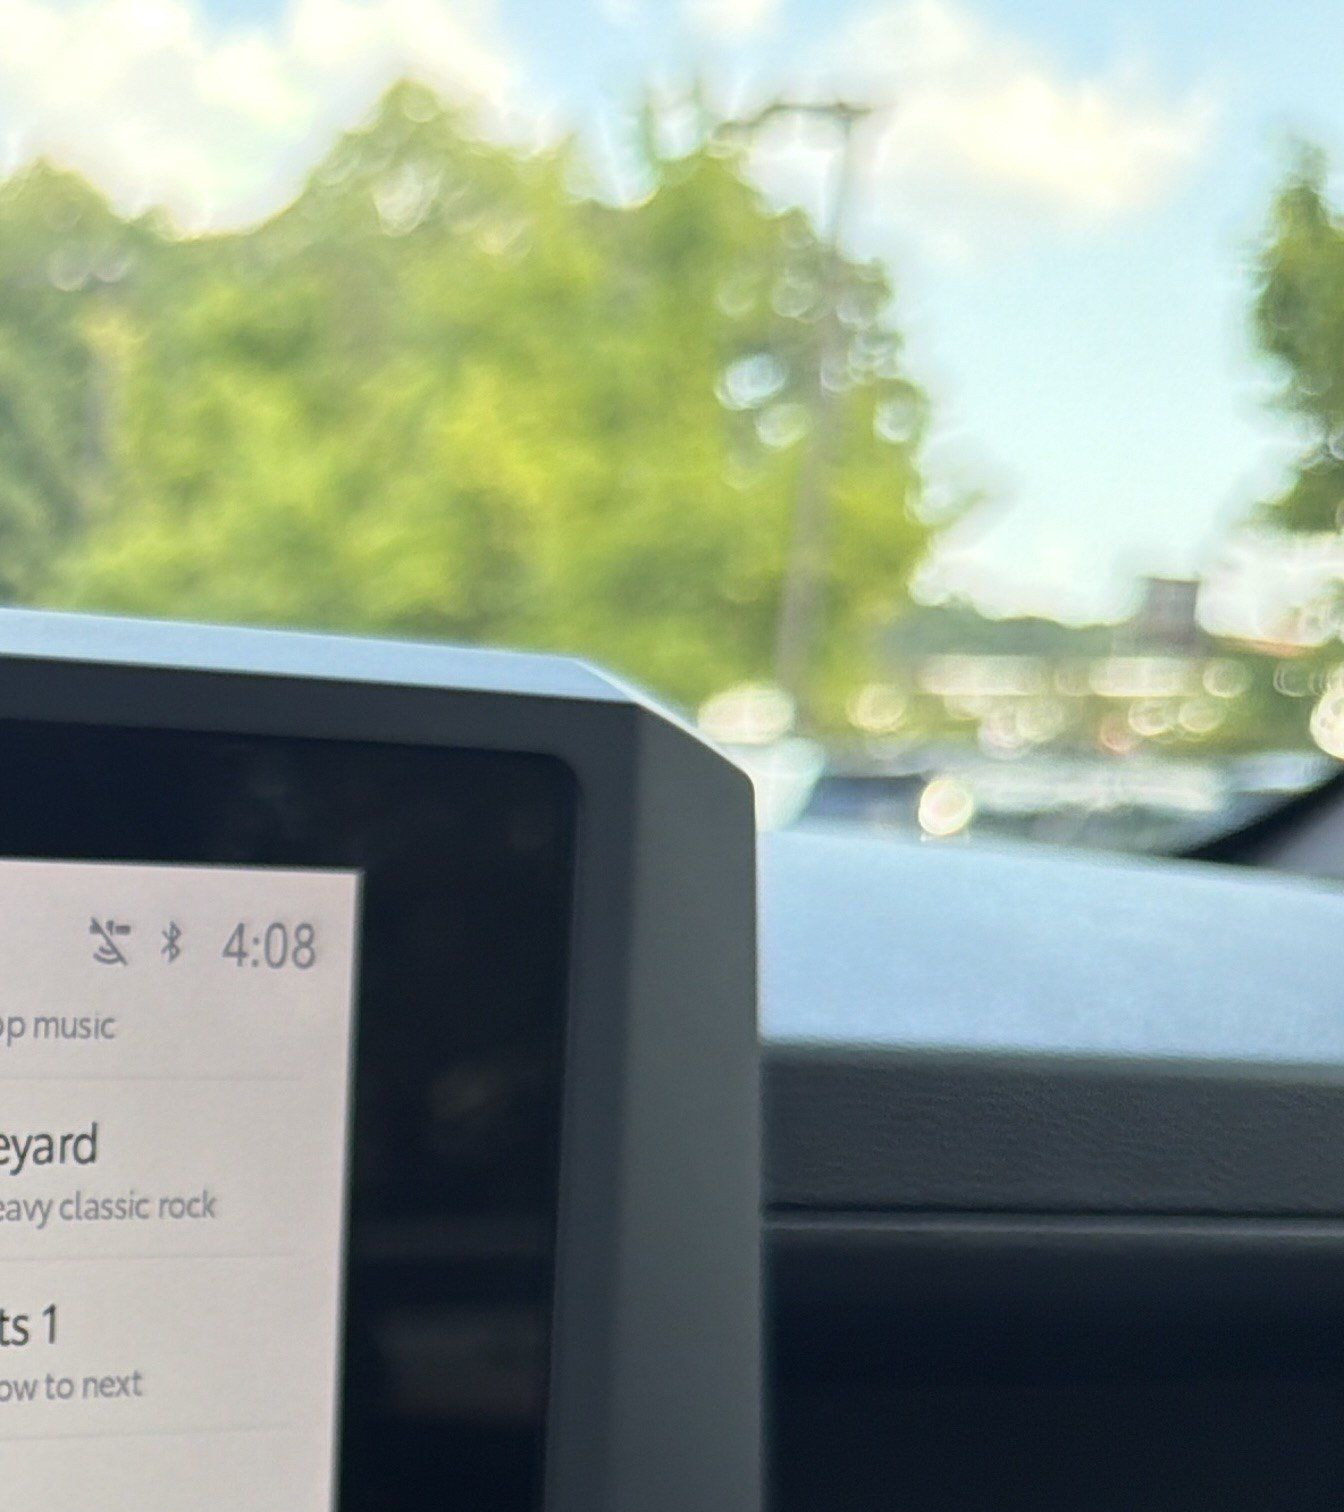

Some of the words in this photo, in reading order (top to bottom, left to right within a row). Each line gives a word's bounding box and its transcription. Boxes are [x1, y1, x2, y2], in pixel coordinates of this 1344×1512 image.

[222, 920, 316, 969] 4:08
[33, 1009, 117, 1042] music
[59, 1190, 151, 1223] classic
[157, 1190, 217, 1219] rock
[43, 1304, 57, 1346] 1
[44, 1374, 76, 1401] to
[82, 1371, 144, 1400] next
